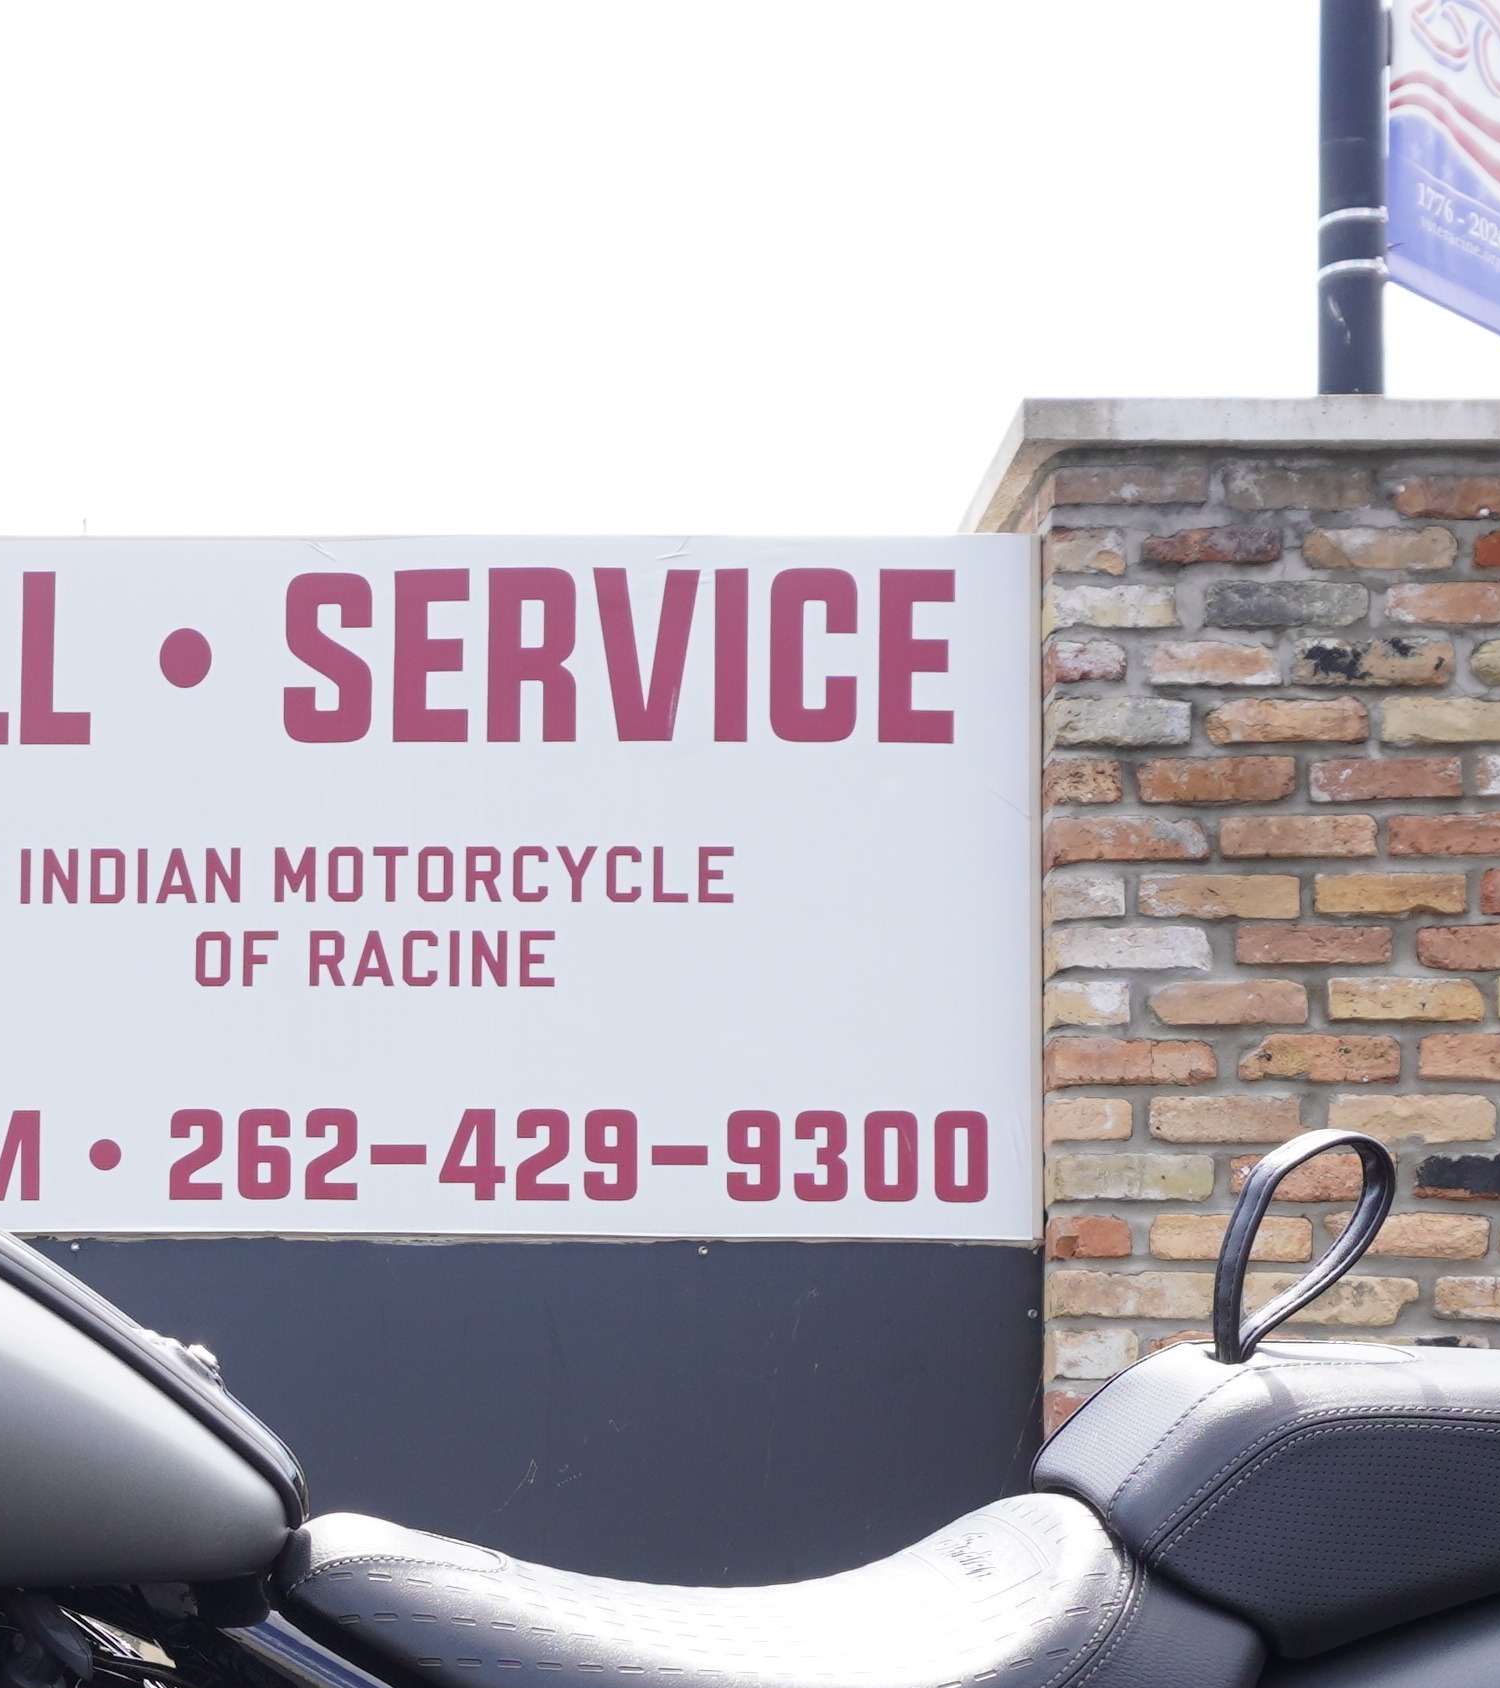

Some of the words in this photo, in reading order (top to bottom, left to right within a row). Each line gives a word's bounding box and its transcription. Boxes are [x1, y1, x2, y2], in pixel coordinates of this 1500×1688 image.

[1417, 182, 1453, 224] 1776
[285, 568, 954, 743] SERVICE
[20, 848, 242, 904] INDIAN
[274, 845, 734, 904] MOTORCYCLE
[195, 930, 277, 988] OF
[309, 930, 556, 988] RACINE
[168, 1107, 989, 1204] 262-429-9300
